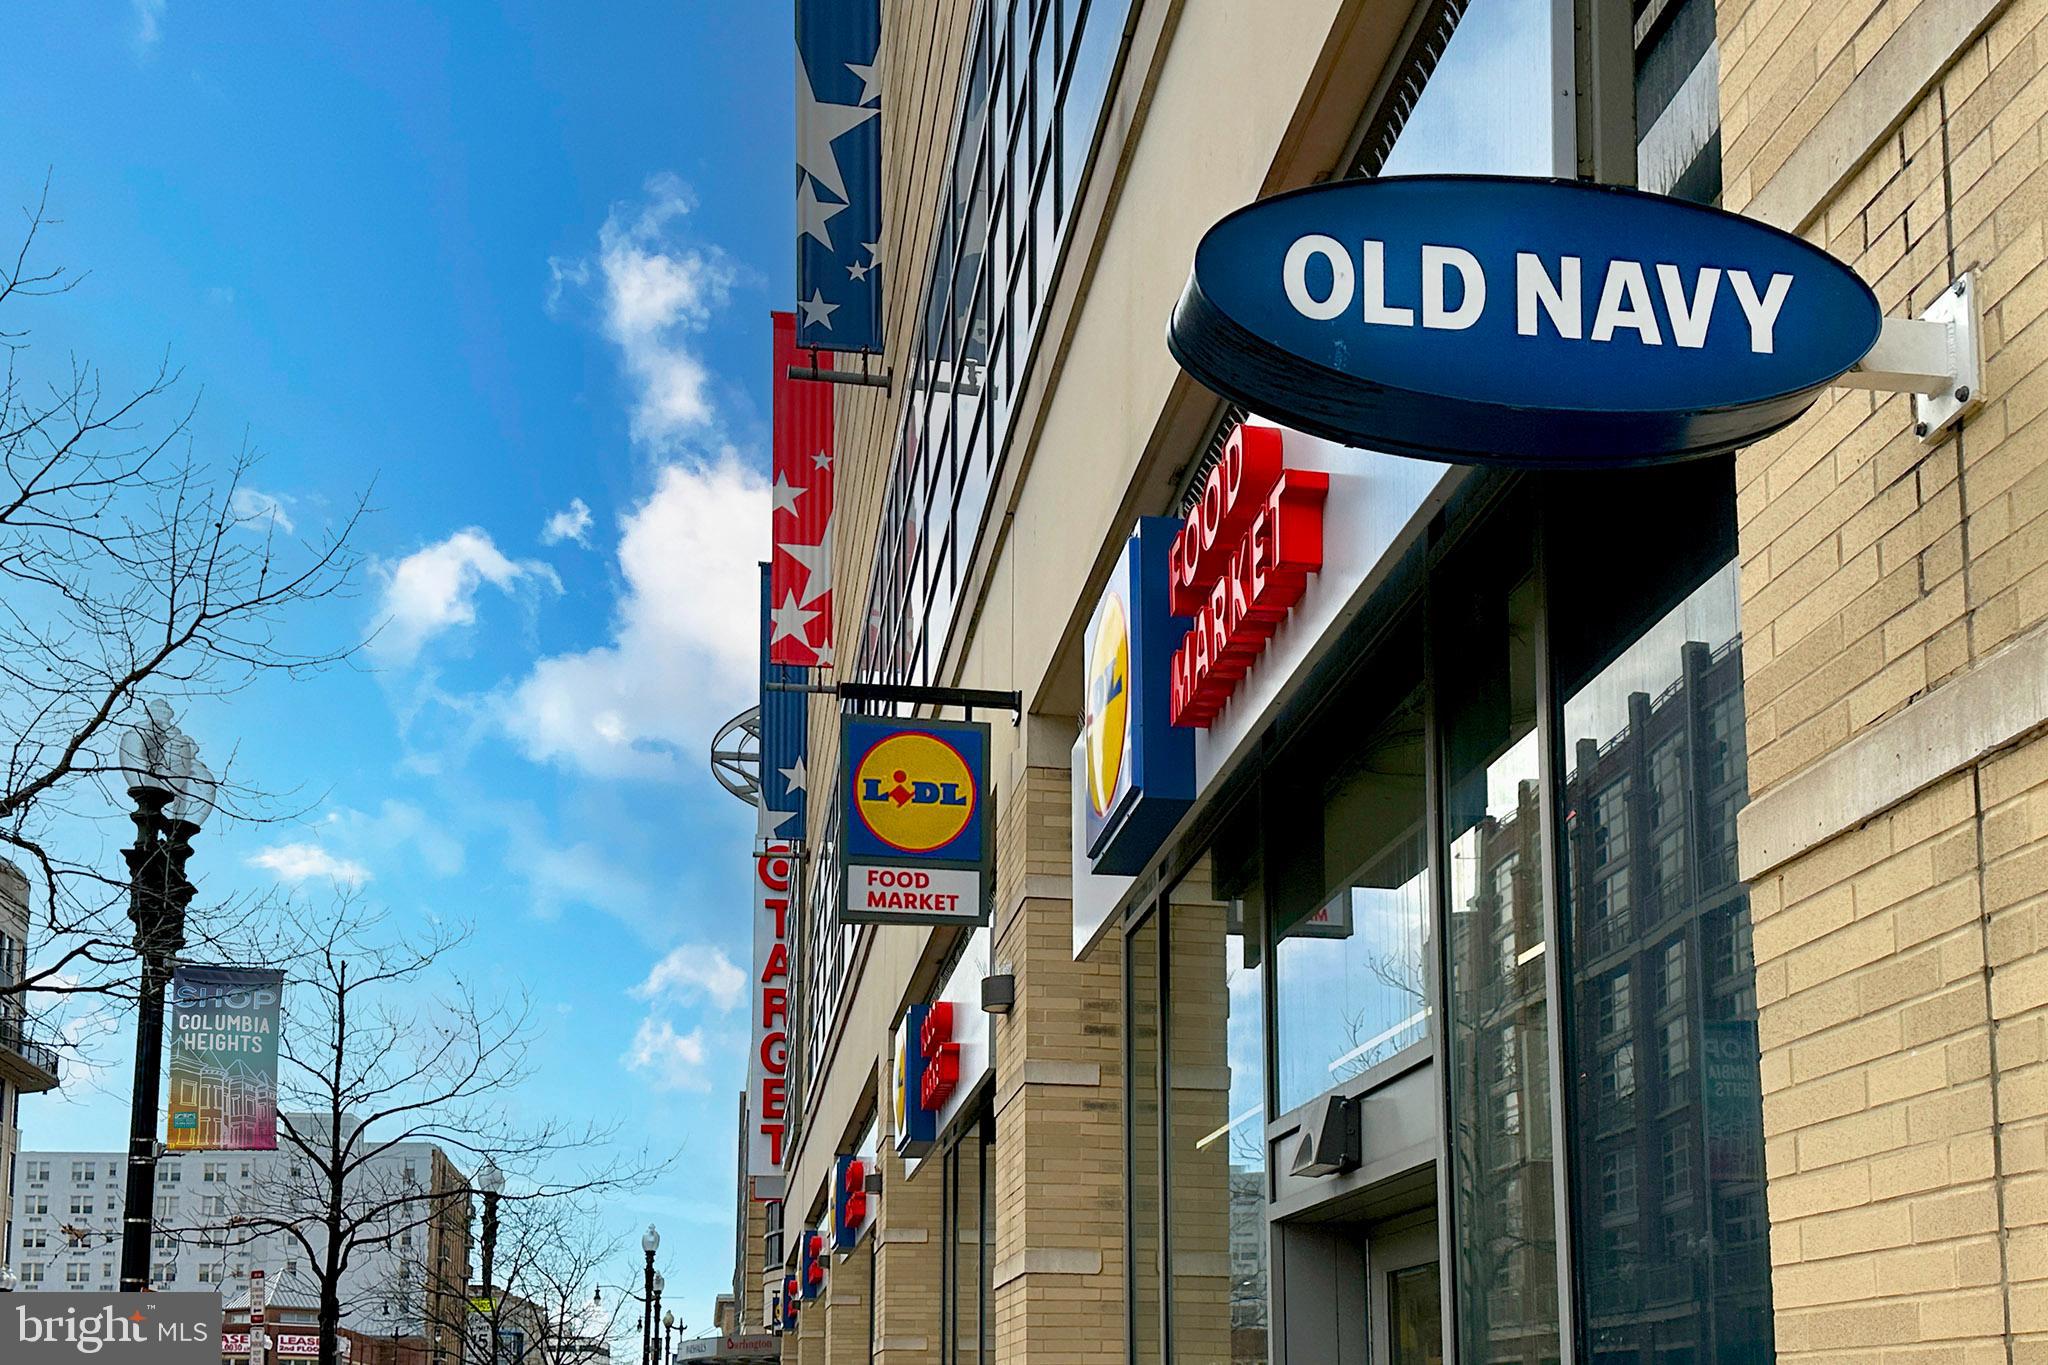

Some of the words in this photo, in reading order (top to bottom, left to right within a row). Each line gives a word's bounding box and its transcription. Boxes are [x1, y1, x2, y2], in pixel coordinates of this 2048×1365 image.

[1282, 233, 1486, 331] OLD
[1516, 251, 1794, 355] NAVY
[1169, 423, 1255, 617] FOOD
[1171, 468, 1295, 728] MARKET
[867, 869, 930, 889] FOOD
[867, 890, 960, 912] MARKET
[176, 985, 278, 1010] SHOP
[178, 1014, 270, 1034] COLUMBIA
[760, 898, 789, 1166] TARGET
[184, 1032, 263, 1054] HEIGHTS
[222, 1334, 249, 1344] ASE
